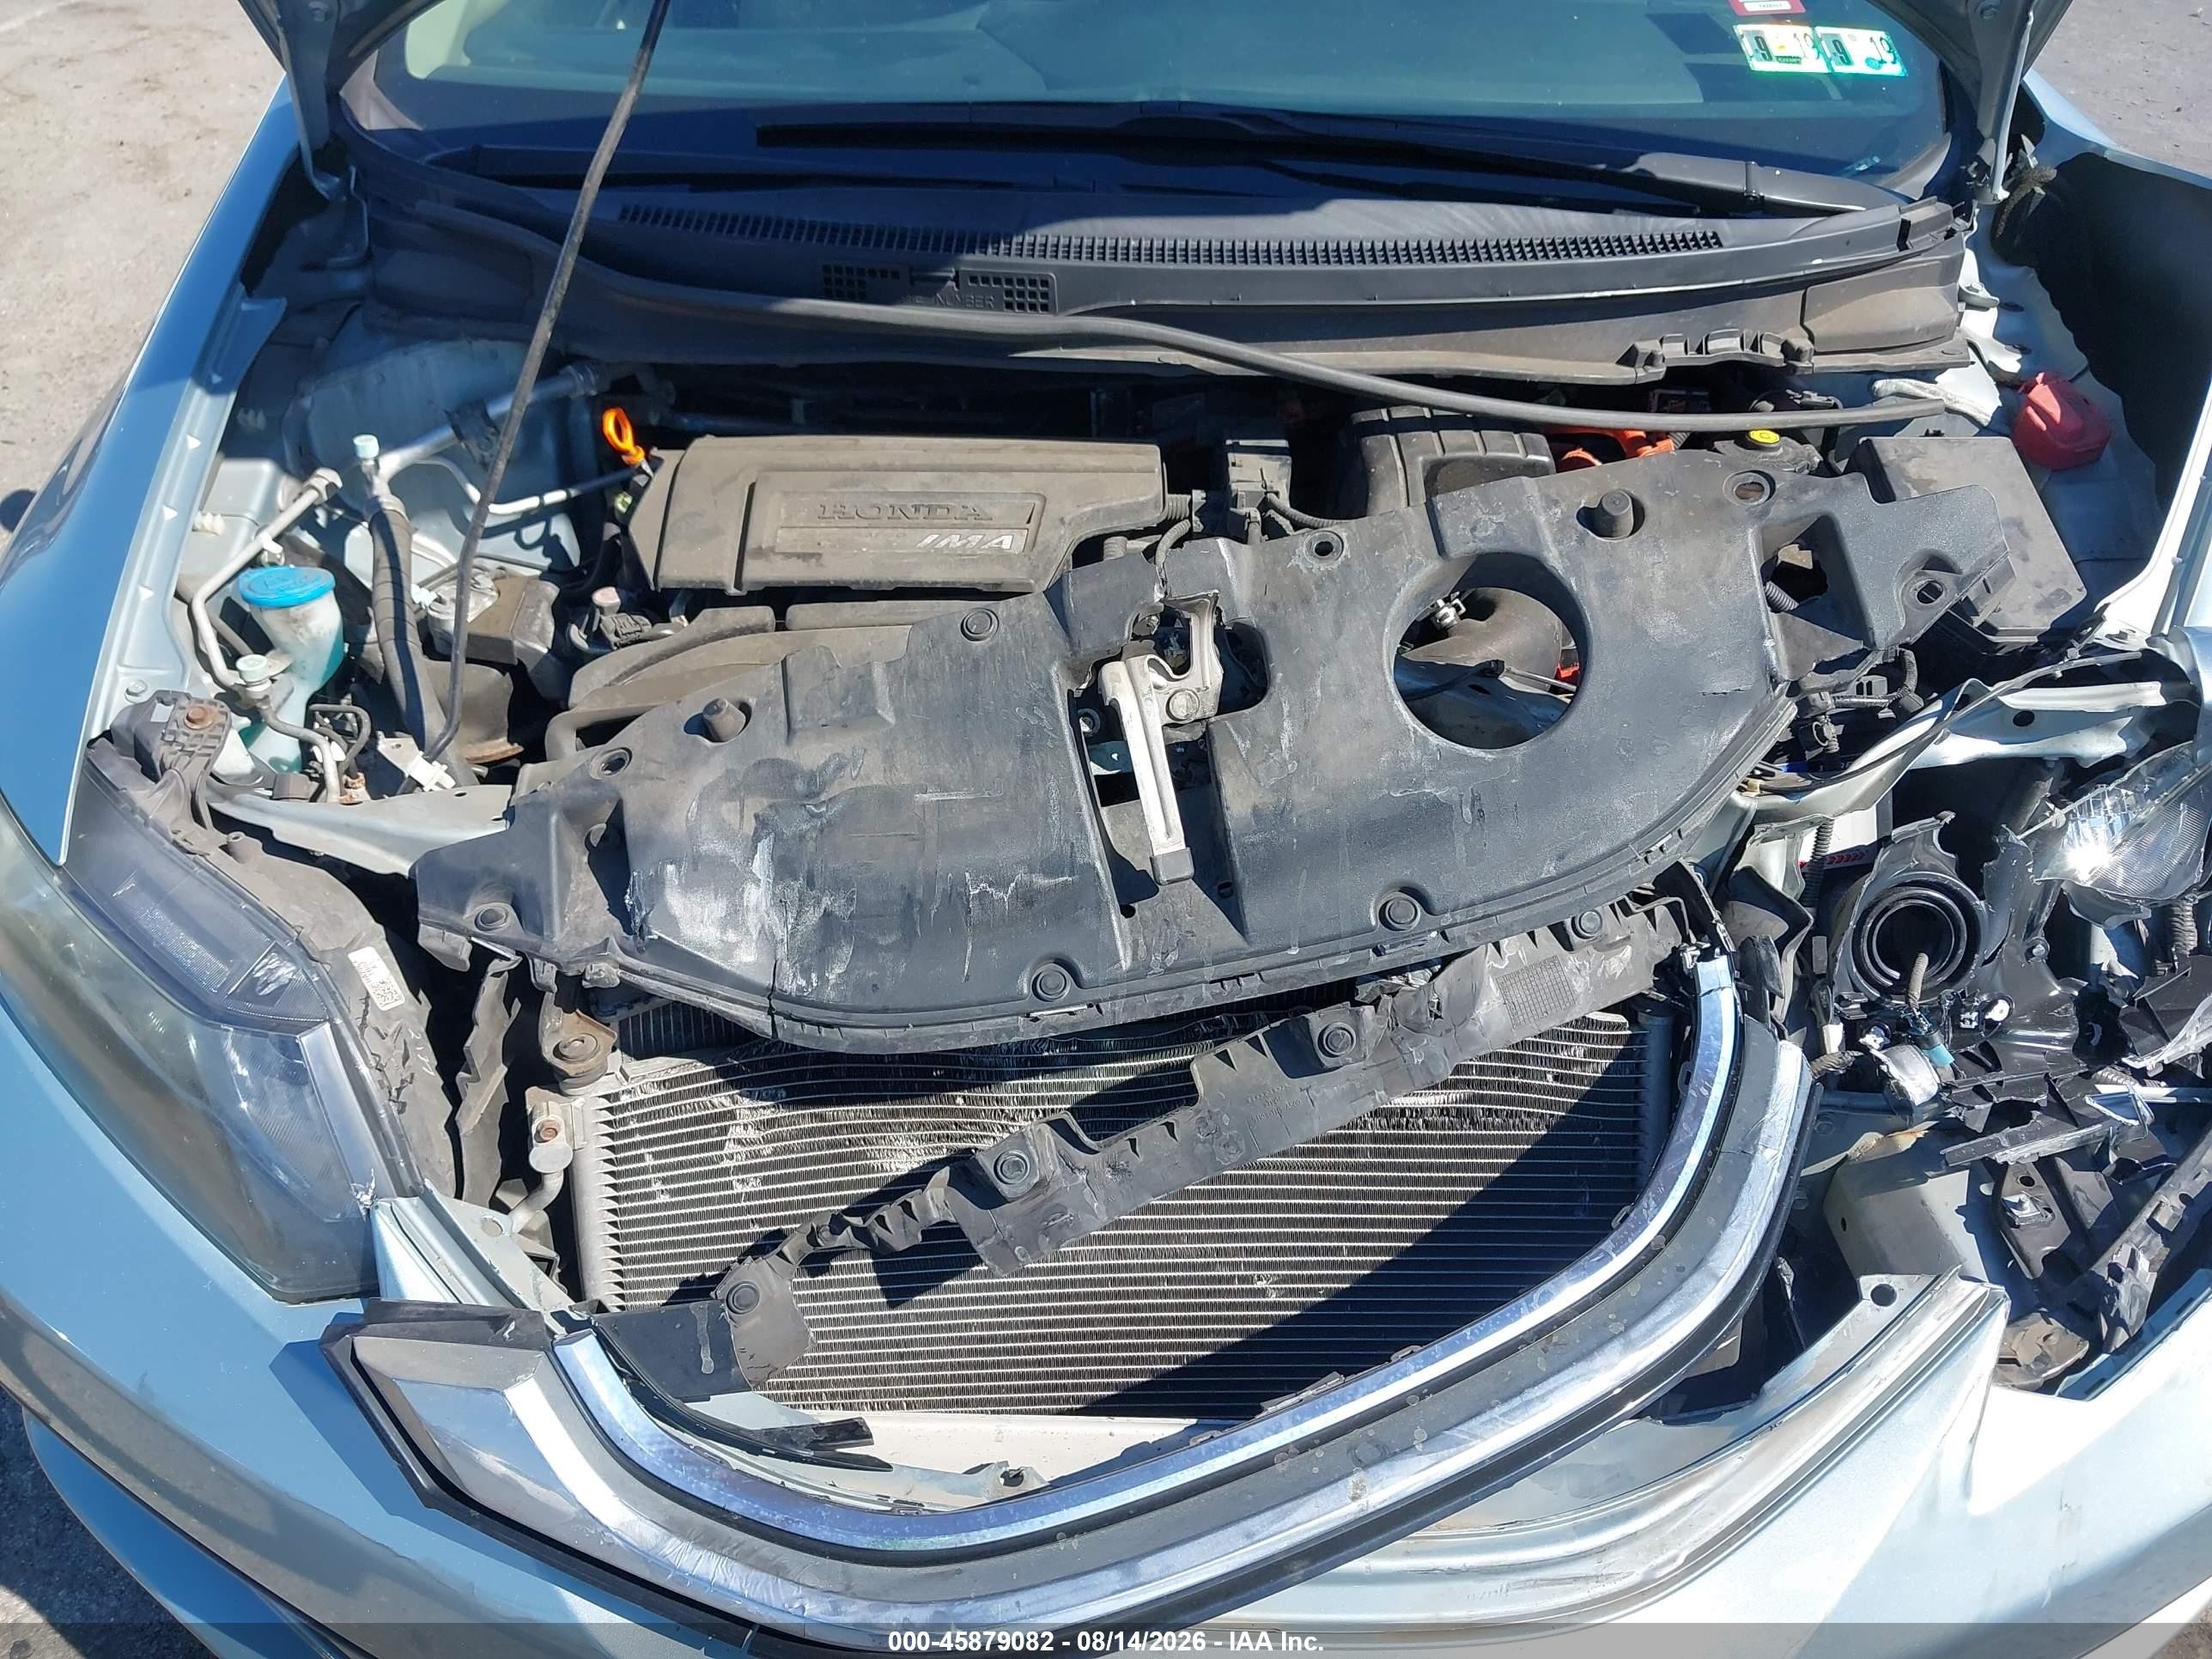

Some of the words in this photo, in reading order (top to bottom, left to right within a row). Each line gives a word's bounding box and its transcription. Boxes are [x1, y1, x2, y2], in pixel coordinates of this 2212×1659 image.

[1754, 35, 1772, 61] 9
[1832, 40, 1851, 65] 9
[935, 293, 995, 310] NUMBER
[817, 501, 994, 521] HONDA
[915, 533, 1016, 550] IMA
